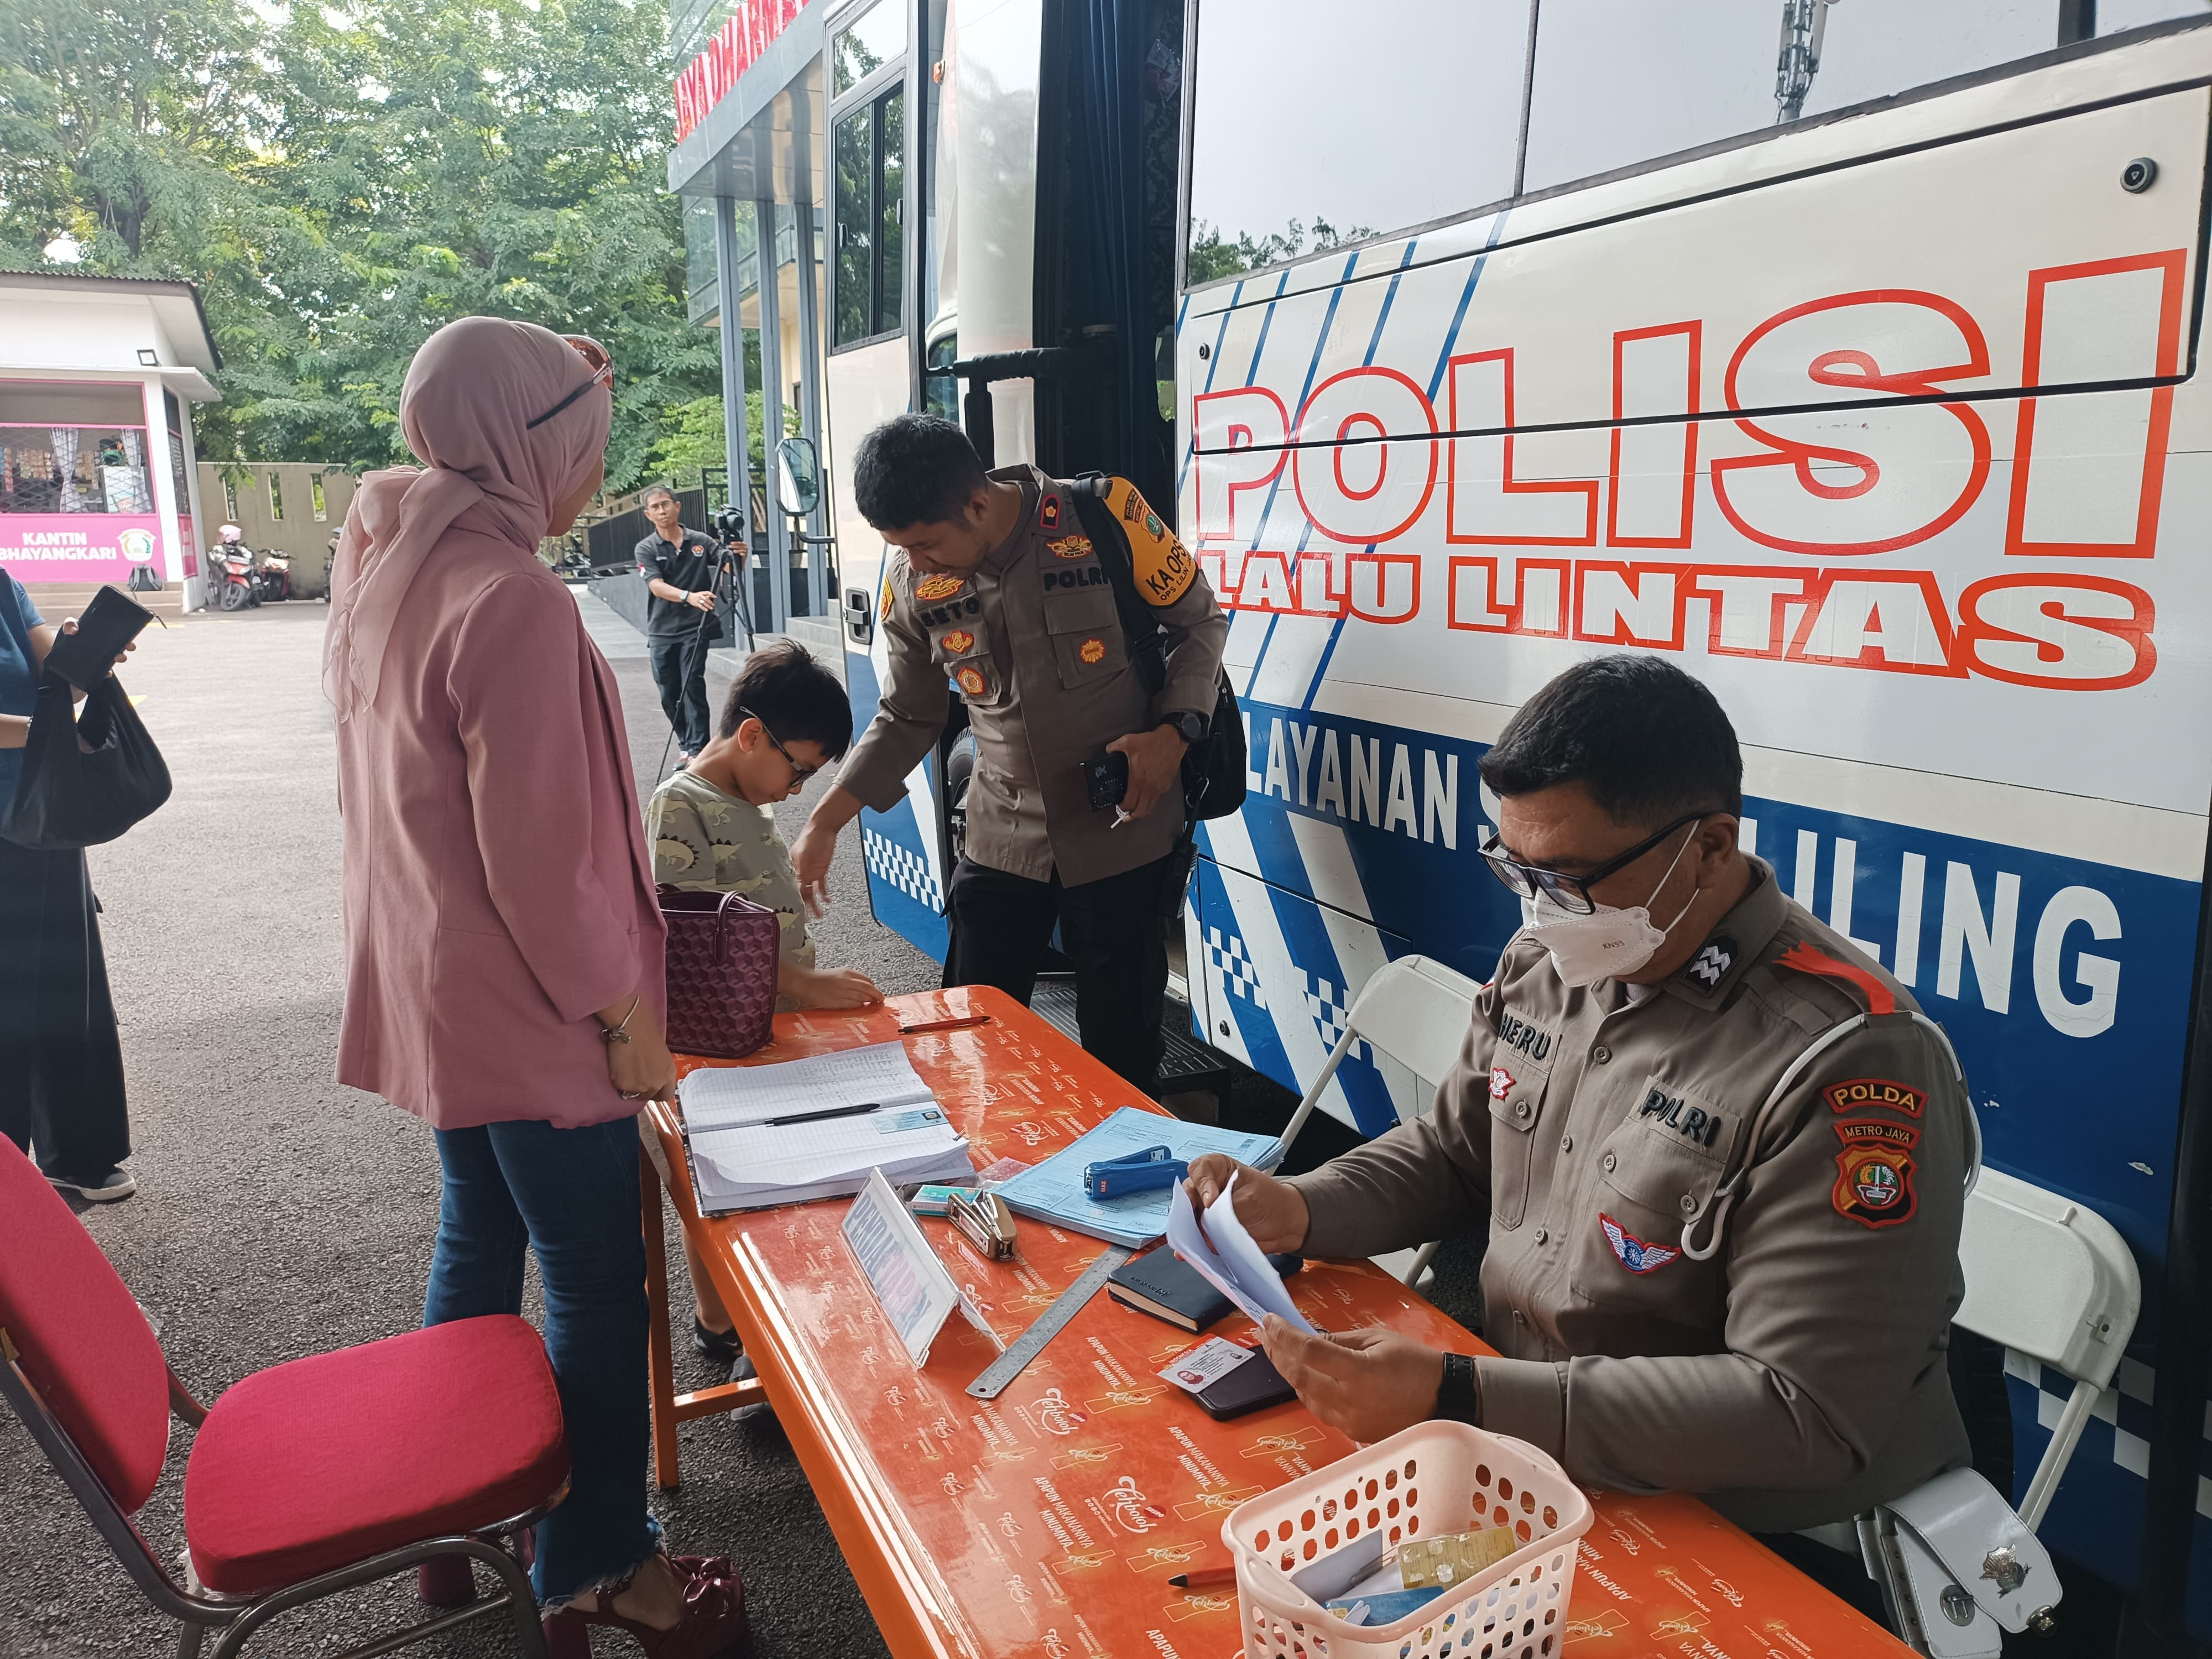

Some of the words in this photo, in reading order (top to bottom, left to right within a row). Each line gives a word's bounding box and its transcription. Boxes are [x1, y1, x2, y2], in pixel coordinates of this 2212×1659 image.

[1193, 248, 2187, 559] POLISI
[0, 546, 117, 561] BHAYANGKARI
[23, 532, 87, 545] KANTIN
[1145, 568, 1175, 596] KA
[1166, 539, 1187, 574] OPS
[919, 596, 980, 628] SETO
[1160, 586, 1176, 601] OPS
[1197, 549, 1421, 624] LALU
[1447, 555, 2157, 691] LINTAS
[1241, 711, 1458, 851] LAYANAN
[1602, 940, 1625, 950] KN95
[1498, 1013, 1551, 1061] HERU
[1640, 1089, 1721, 1147] POLRI
[1833, 1083, 1915, 1111] POLDA
[1844, 1126, 1883, 1138] METRO
[1885, 1127, 1910, 1143] JAYA
[1086, 1335, 1110, 1358] APAPUN
[1104, 1353, 1138, 1388] MAKANANNYA
[1168, 1349, 1194, 1364] INDONESIA
[985, 1405, 1019, 1447] MAKANANNYA
[1030, 1387, 1078, 1436] Tehbotol
[1167, 1425, 1194, 1450] APAPUN
[1188, 1446, 1230, 1488] MAKANANNYA
[1033, 1476, 1061, 1507] APAPUN
[1052, 1500, 1095, 1549] MAKANANNYA
[1102, 1475, 1159, 1533] Tehbotol
[1588, 1568, 1633, 1601] APAPUN
